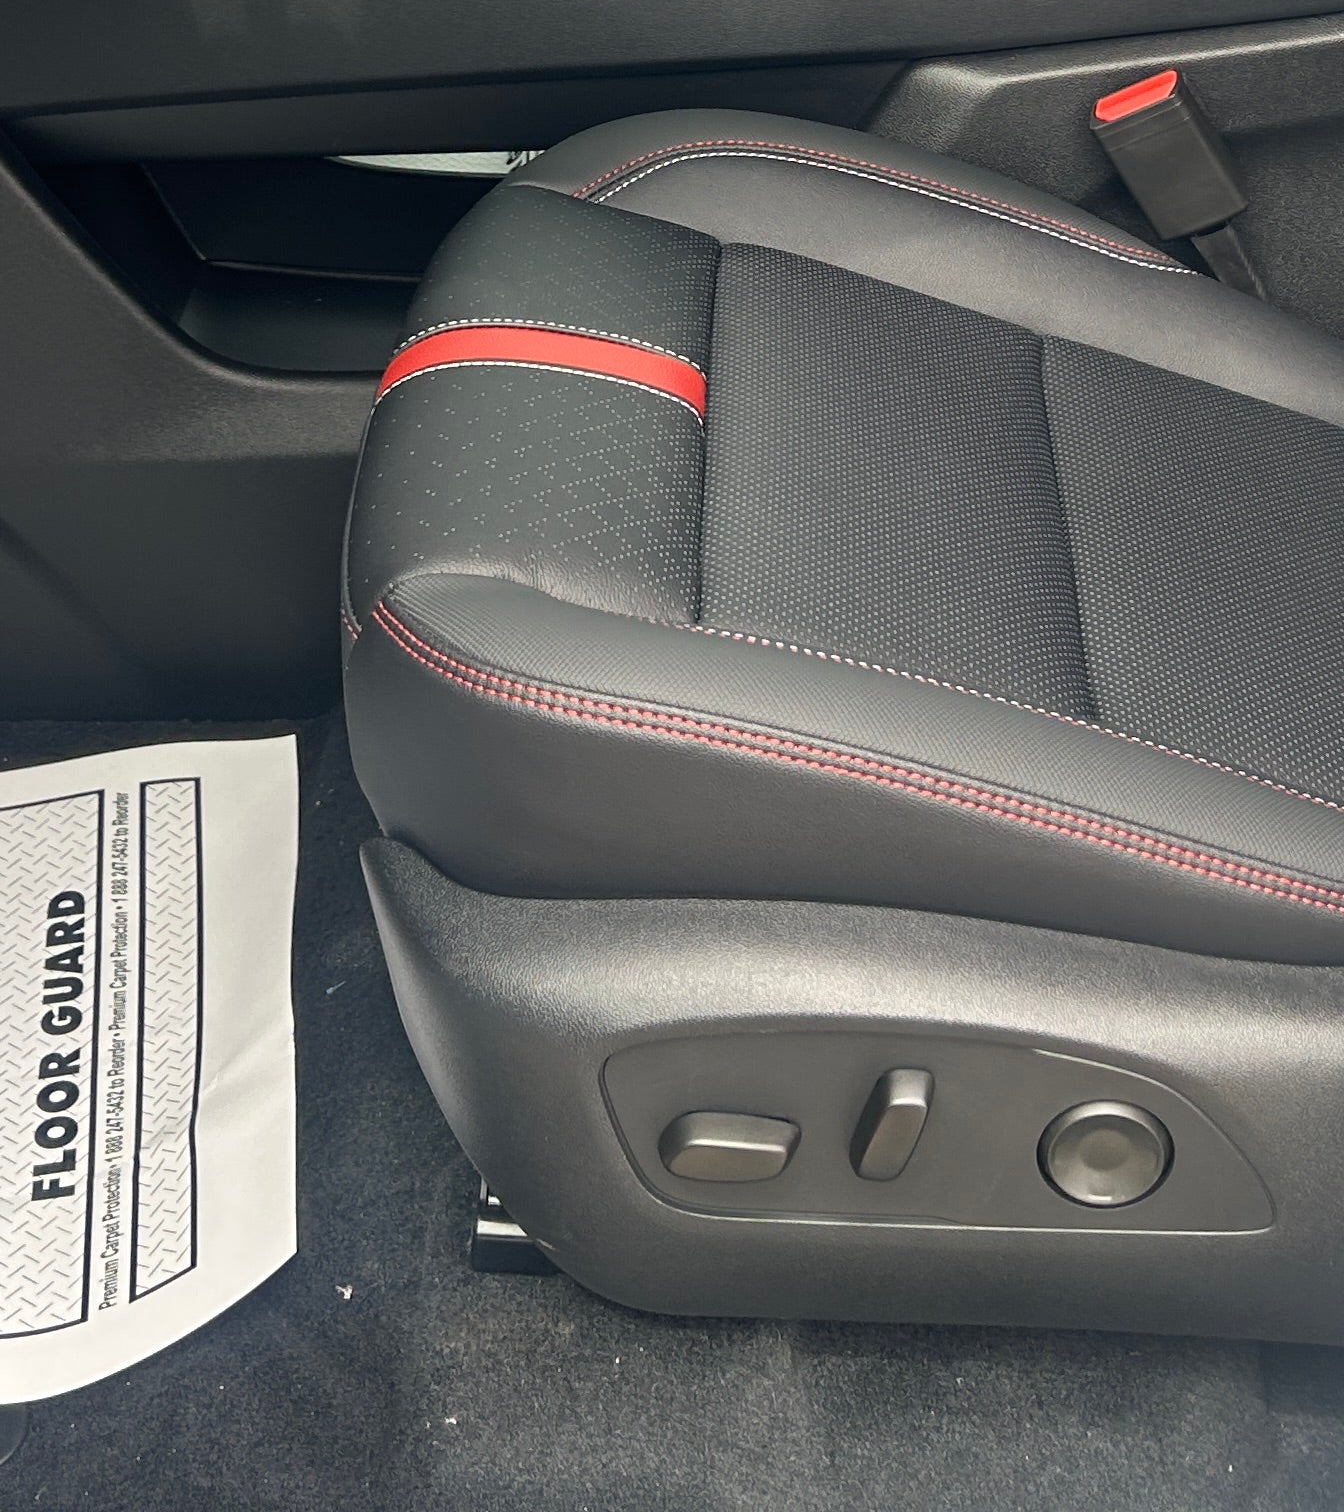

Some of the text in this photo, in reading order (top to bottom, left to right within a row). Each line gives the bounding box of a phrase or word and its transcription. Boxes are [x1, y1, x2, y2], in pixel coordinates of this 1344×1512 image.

[111, 838, 128, 877] 247-5432
[110, 911, 128, 958] Protection
[109, 959, 132, 989] Carpet
[108, 990, 127, 1030] Premium
[31, 890, 85, 1201] FLOOR GUARD
[107, 1038, 126, 1077] Reorder
[108, 1078, 125, 1089] to
[105, 1090, 125, 1135] 247-5432
[100, 1221, 124, 1259] Carpet
[98, 1258, 119, 1311] Premium
